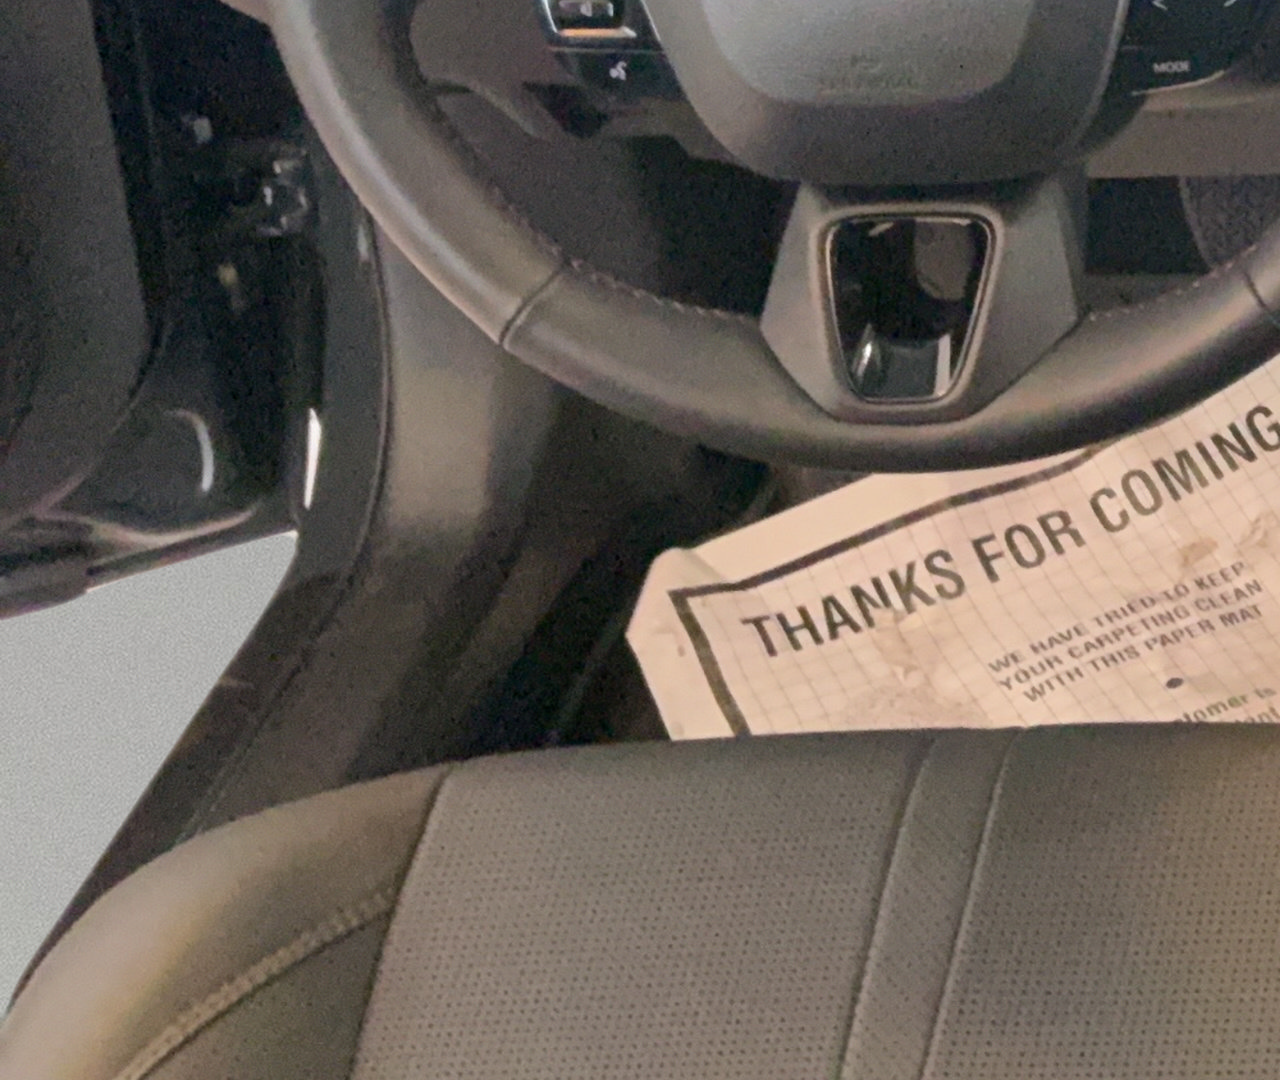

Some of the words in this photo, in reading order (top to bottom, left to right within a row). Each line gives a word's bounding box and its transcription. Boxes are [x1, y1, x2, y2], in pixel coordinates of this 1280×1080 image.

[1153, 61, 1191, 73] MODE
[740, 549, 965, 657] THANKS
[972, 510, 1086, 583] FOR
[987, 649, 1025, 675] WE
[1030, 622, 1088, 658] HAVE
[1093, 595, 1157, 628] TRIED
[1162, 583, 1190, 605] TO
[1193, 561, 1246, 593] KEEP
[998, 653, 1063, 692] YOUR
[1067, 605, 1191, 661] CARPETING
[1193, 578, 1264, 613] CLEAN
[1022, 665, 1084, 703] WITH
[1090, 643, 1141, 674] THIS
[1146, 618, 1216, 652] PAPER
[1218, 603, 1264, 629] MAT
